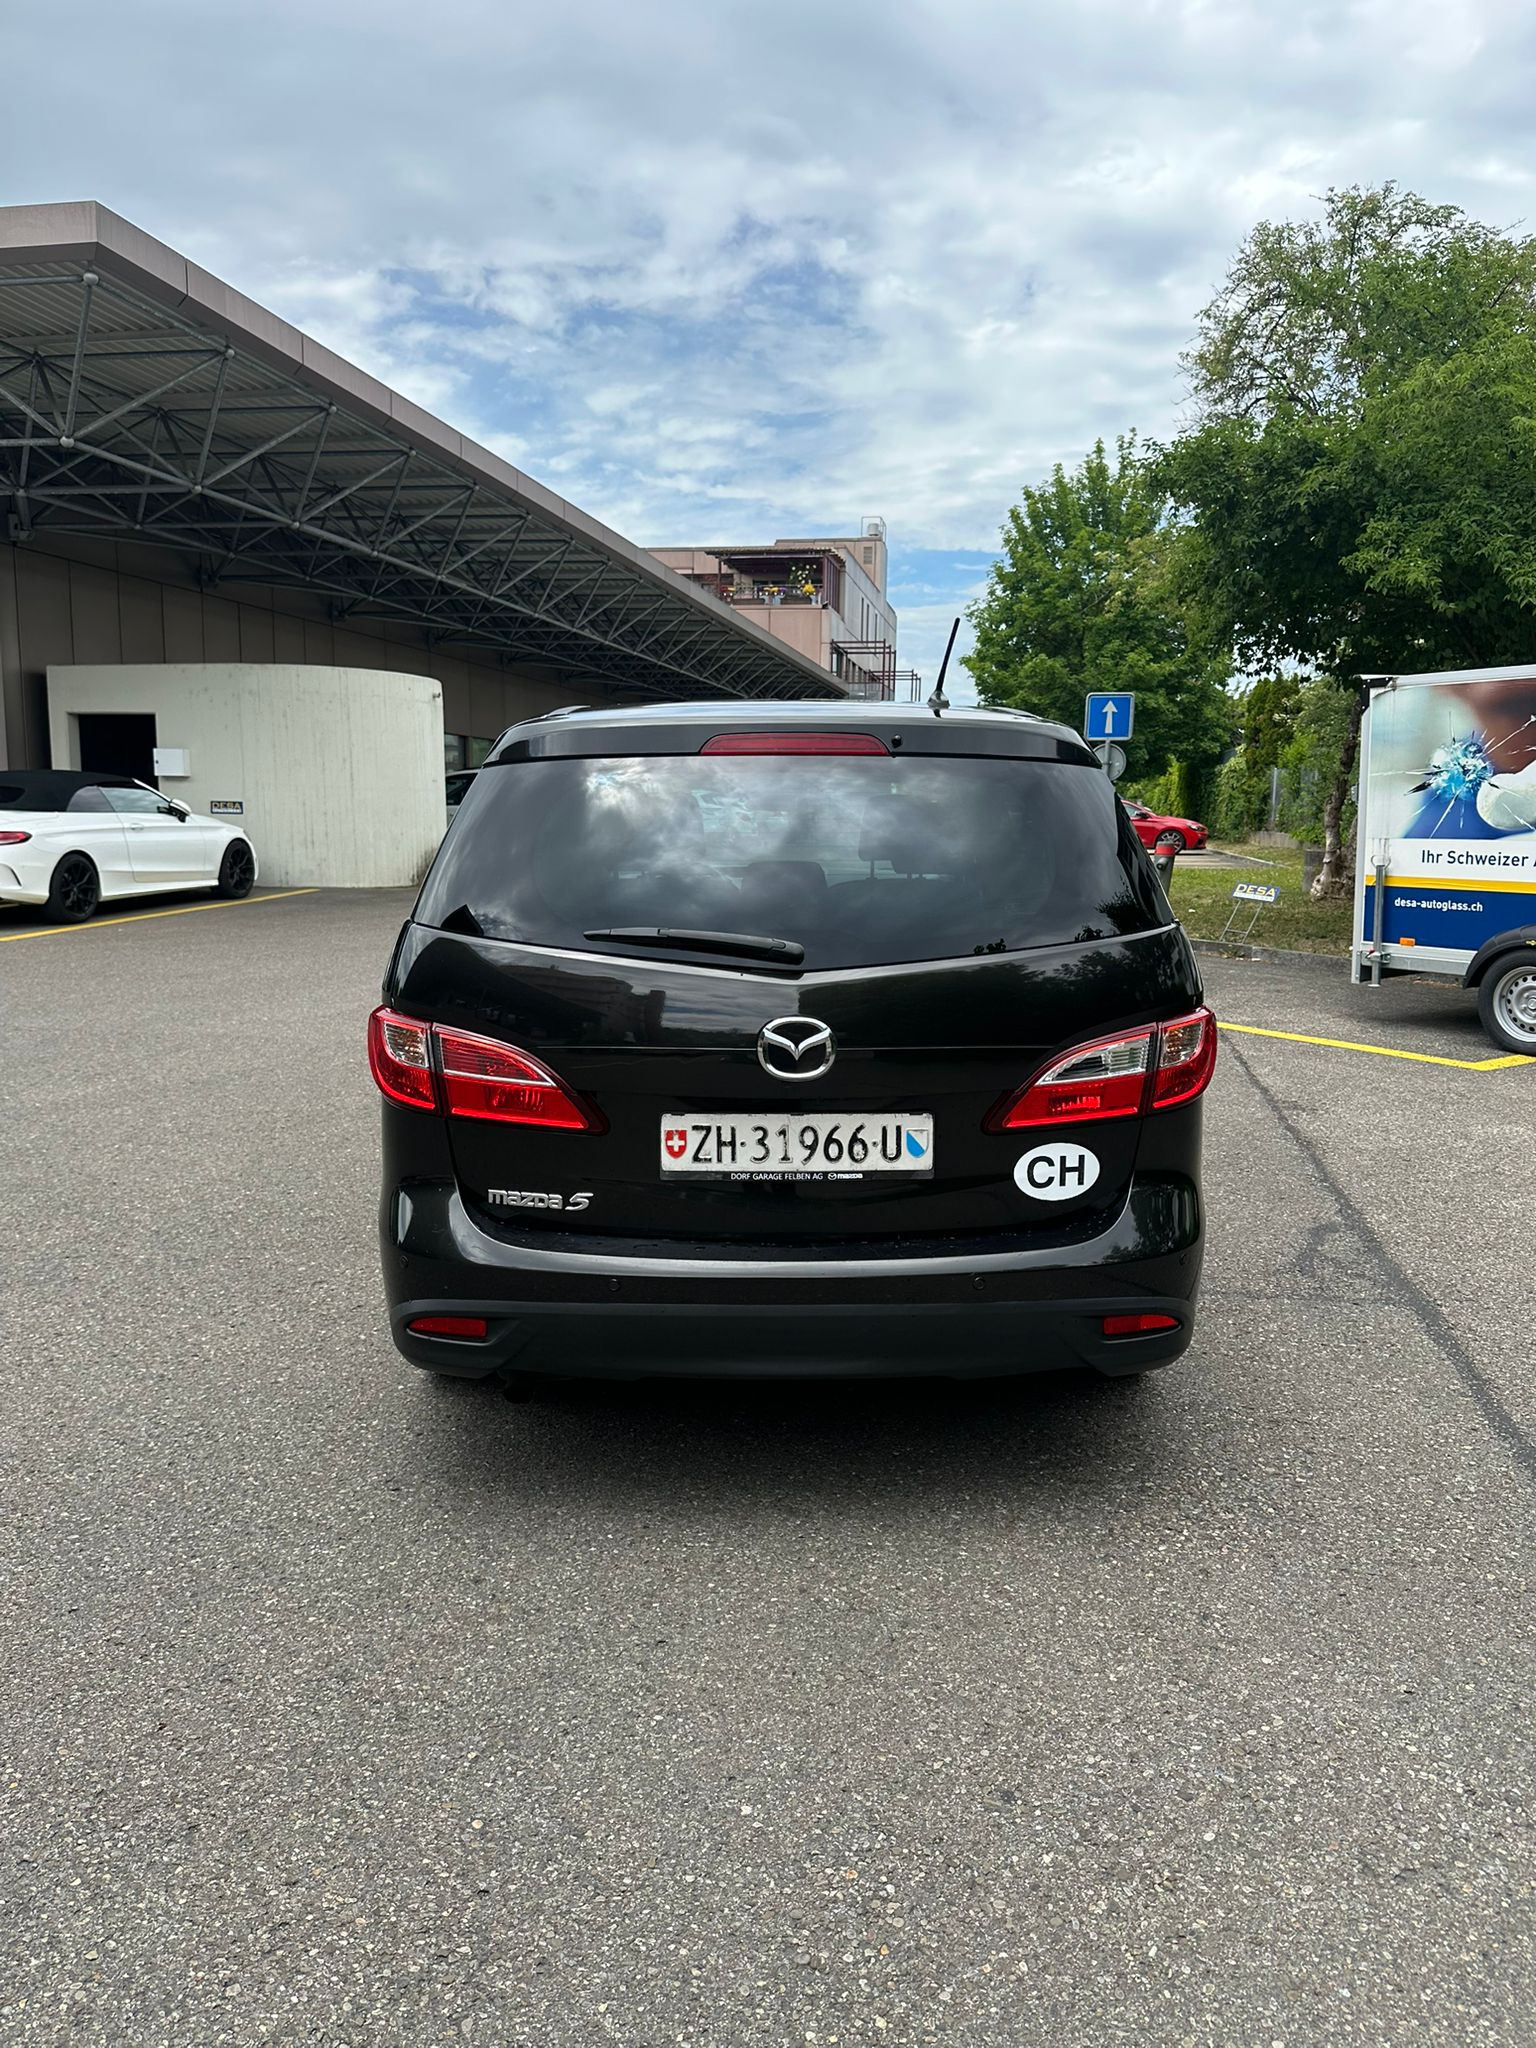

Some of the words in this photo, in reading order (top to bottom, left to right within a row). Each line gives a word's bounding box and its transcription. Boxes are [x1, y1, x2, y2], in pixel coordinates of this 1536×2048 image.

[1420, 849, 1443, 864] Ihr
[1447, 850, 1529, 867] Schweizer
[1235, 883, 1276, 897] DESA
[1394, 897, 1483, 912] desa-autoglass.ch
[730, 1172, 751, 1180] DORF
[752, 1172, 783, 1180] GARAGE
[784, 1172, 811, 1180] FELBEN
[812, 1172, 824, 1180] AG
[1027, 1154, 1085, 1189] CH
[488, 1189, 563, 1210] mazda
[565, 1192, 594, 1211] 5
